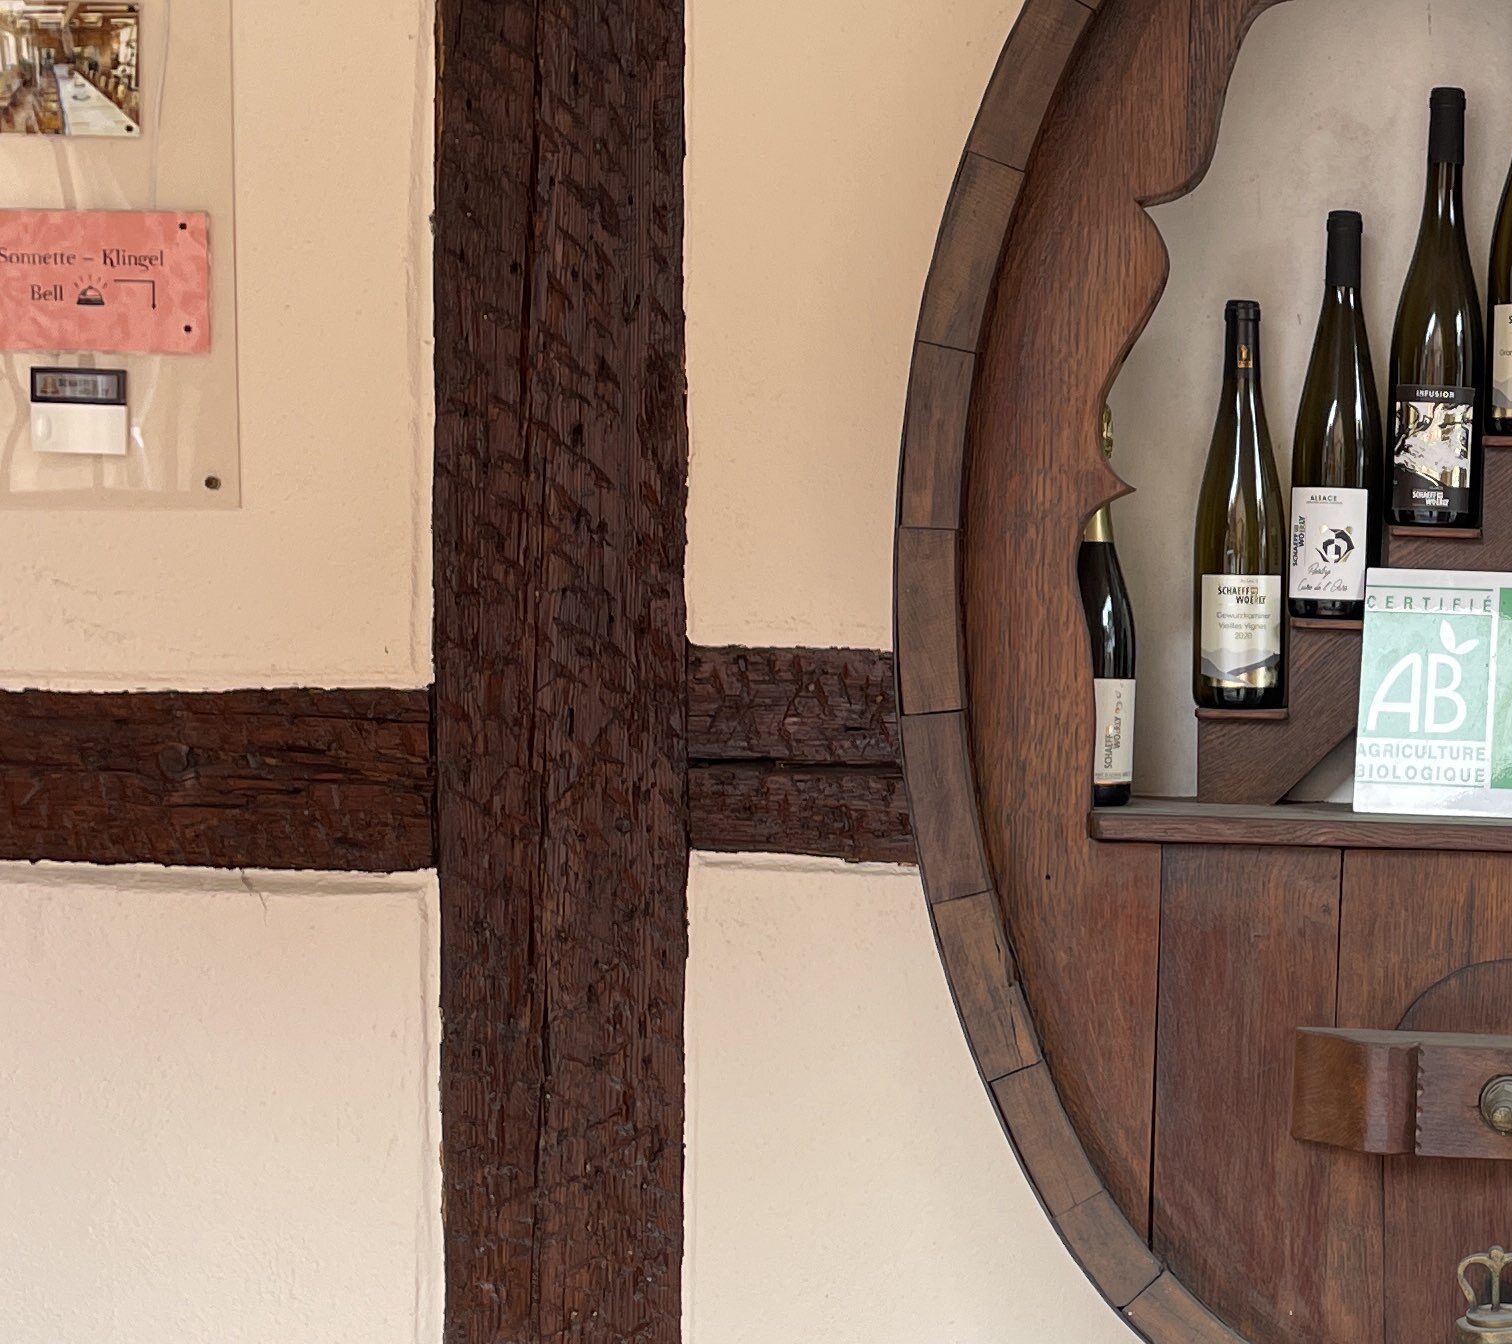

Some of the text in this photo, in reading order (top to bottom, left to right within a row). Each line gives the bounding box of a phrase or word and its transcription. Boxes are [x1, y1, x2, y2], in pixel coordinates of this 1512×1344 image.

[0, 246, 77, 266] Sonnette
[102, 248, 164, 272] Klingel
[31, 283, 64, 302] Bell
[1416, 389, 1455, 399] INFUSION
[1366, 594, 1493, 614] CERTIFIÉ
[1234, 632, 1253, 640] 2020
[1366, 652, 1468, 734] AB
[1358, 742, 1487, 762] AGRICULTURE
[1356, 763, 1486, 783] BIOLOGIQUE
